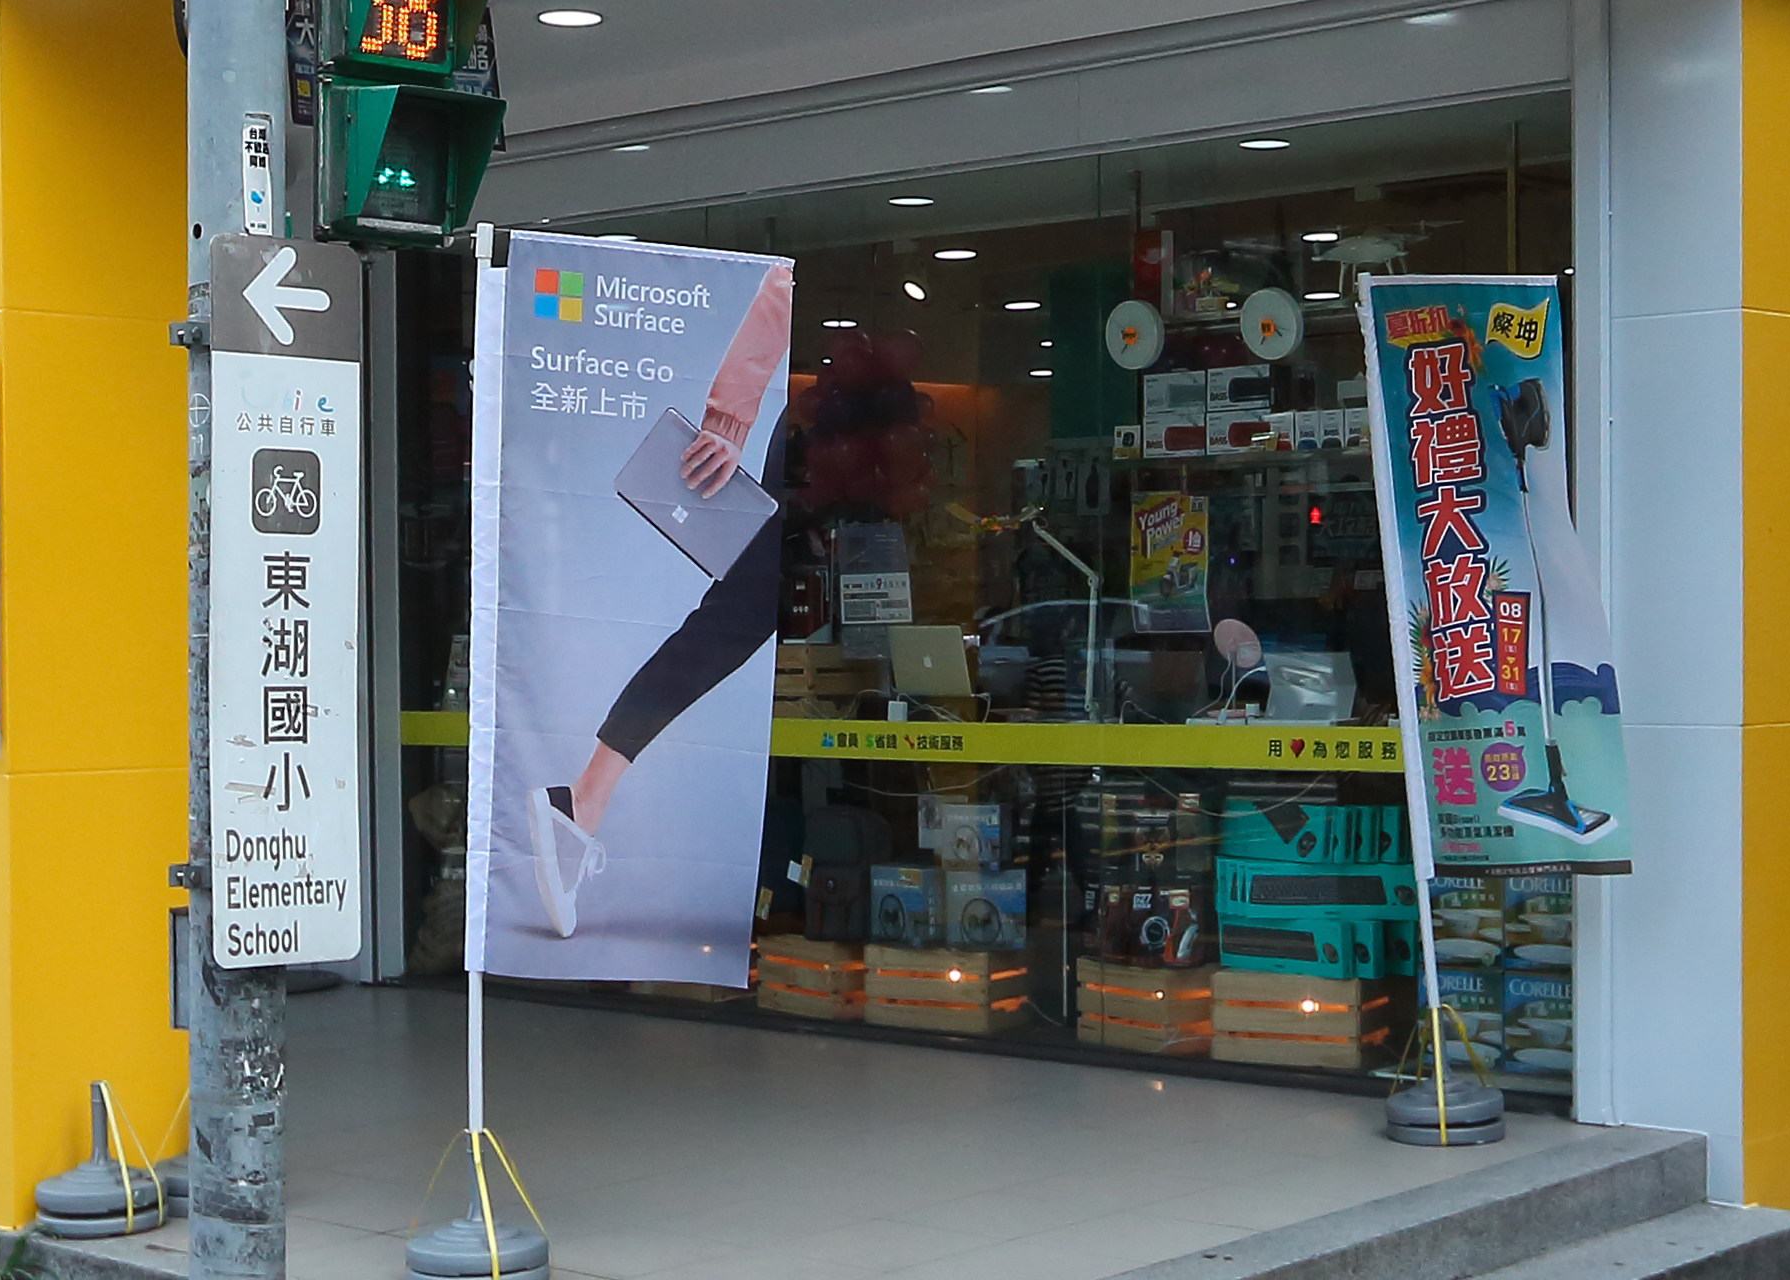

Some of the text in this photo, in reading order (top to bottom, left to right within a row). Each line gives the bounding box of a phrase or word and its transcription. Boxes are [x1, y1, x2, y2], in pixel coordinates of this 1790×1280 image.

[595, 274, 711, 309] Microsoft
[593, 303, 686, 335] Surface
[1490, 310, 1540, 350] 燦坤
[530, 345, 674, 383] Surface Go
[530, 382, 649, 420] 全新上市
[235, 411, 337, 438] 公共自行車
[1138, 501, 1178, 531] Young
[1409, 342, 1496, 703] 好禮大放送
[1146, 513, 1186, 560] Power
[1498, 601, 1523, 619] 08
[1501, 626, 1523, 644] 17
[261, 550, 312, 812] 東湖國小
[1500, 663, 1521, 682] 31
[836, 731, 860, 749] 會員
[915, 734, 965, 752] 技術服務
[1431, 746, 1478, 806] 送
[225, 827, 307, 872] Donghu
[226, 875, 348, 914] Elementary
[227, 921, 299, 957] School
[1436, 974, 1485, 994] ORELLE
